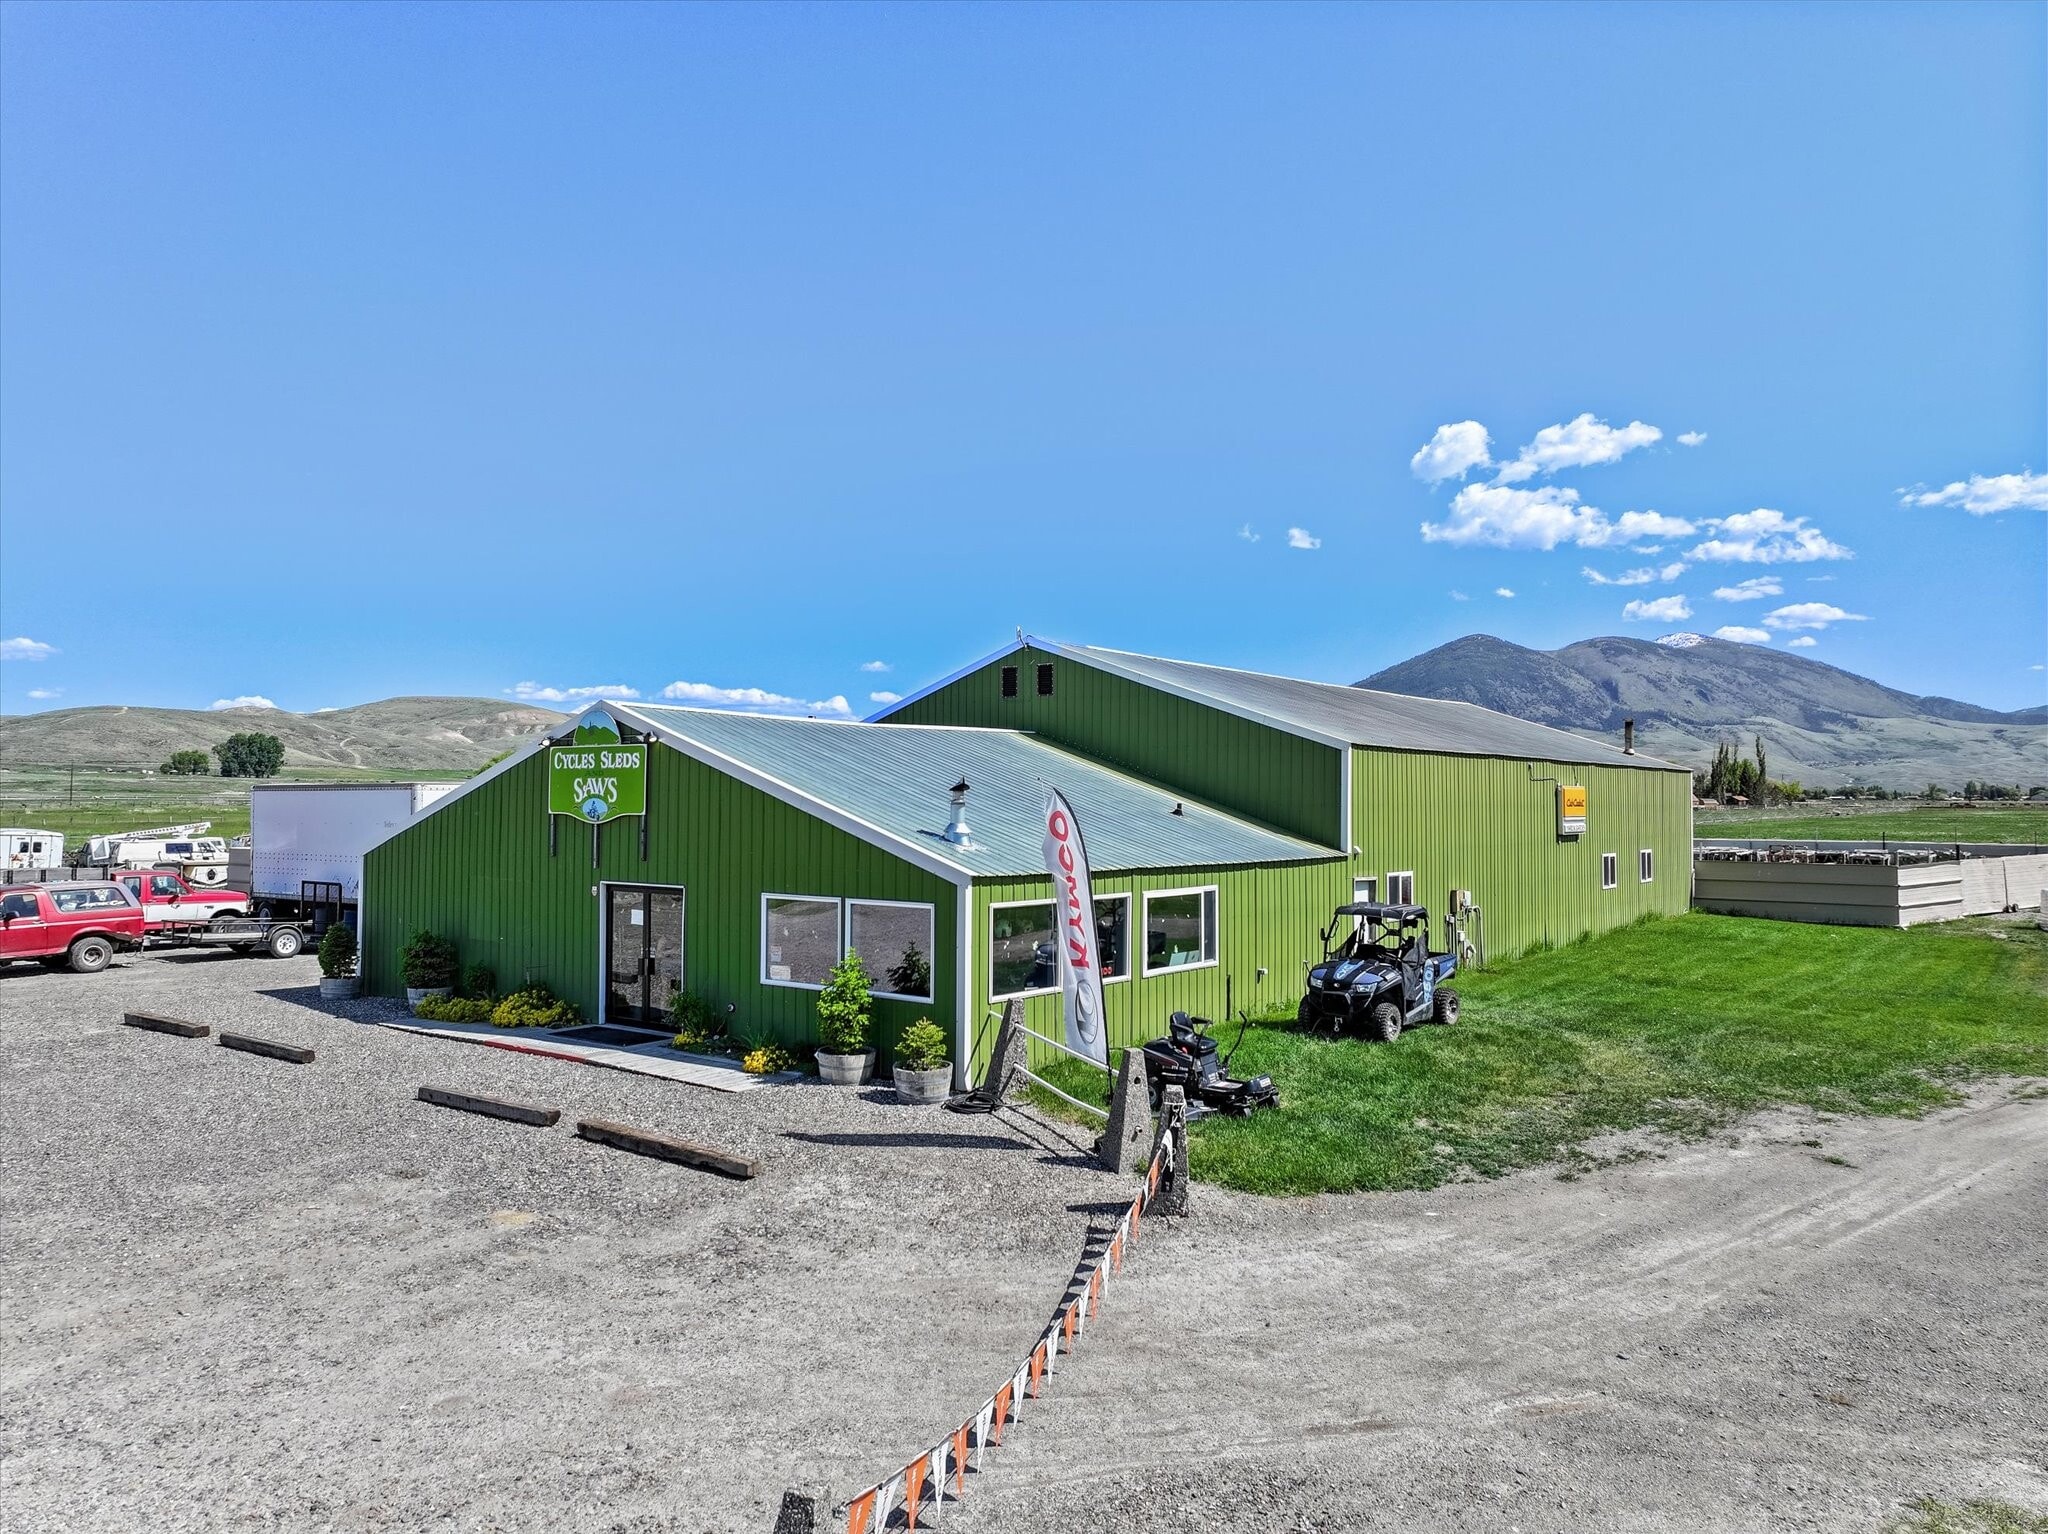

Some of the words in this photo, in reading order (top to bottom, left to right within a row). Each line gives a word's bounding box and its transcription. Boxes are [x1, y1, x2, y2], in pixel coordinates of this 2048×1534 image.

[554, 751, 595, 769] CYCLES
[600, 750, 640, 769] SLEDS
[573, 777, 618, 803] SAWS
[1047, 809, 1090, 970] KYMCO
